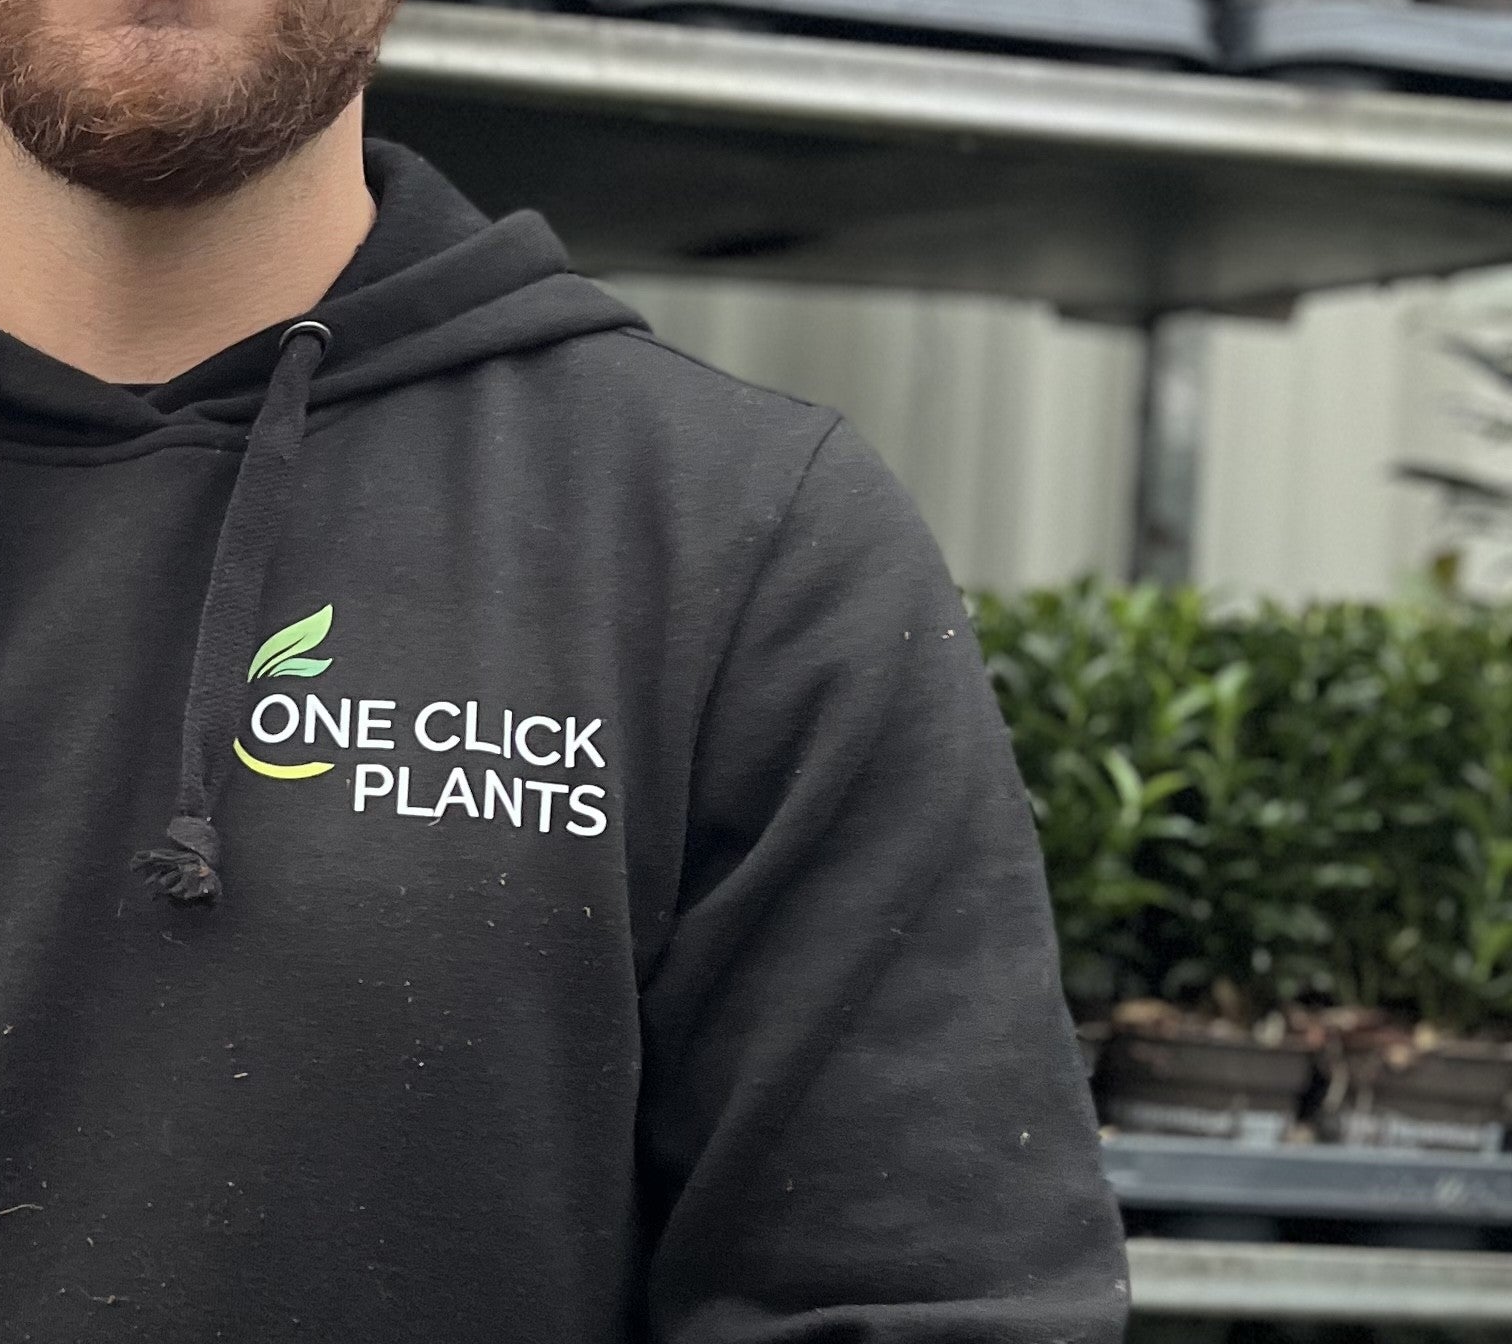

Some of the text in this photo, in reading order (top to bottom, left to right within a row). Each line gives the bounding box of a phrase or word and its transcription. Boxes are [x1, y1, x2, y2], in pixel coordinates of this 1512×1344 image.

[251, 693, 607, 768] ONE CLICK
[353, 763, 608, 837] PLANTS
